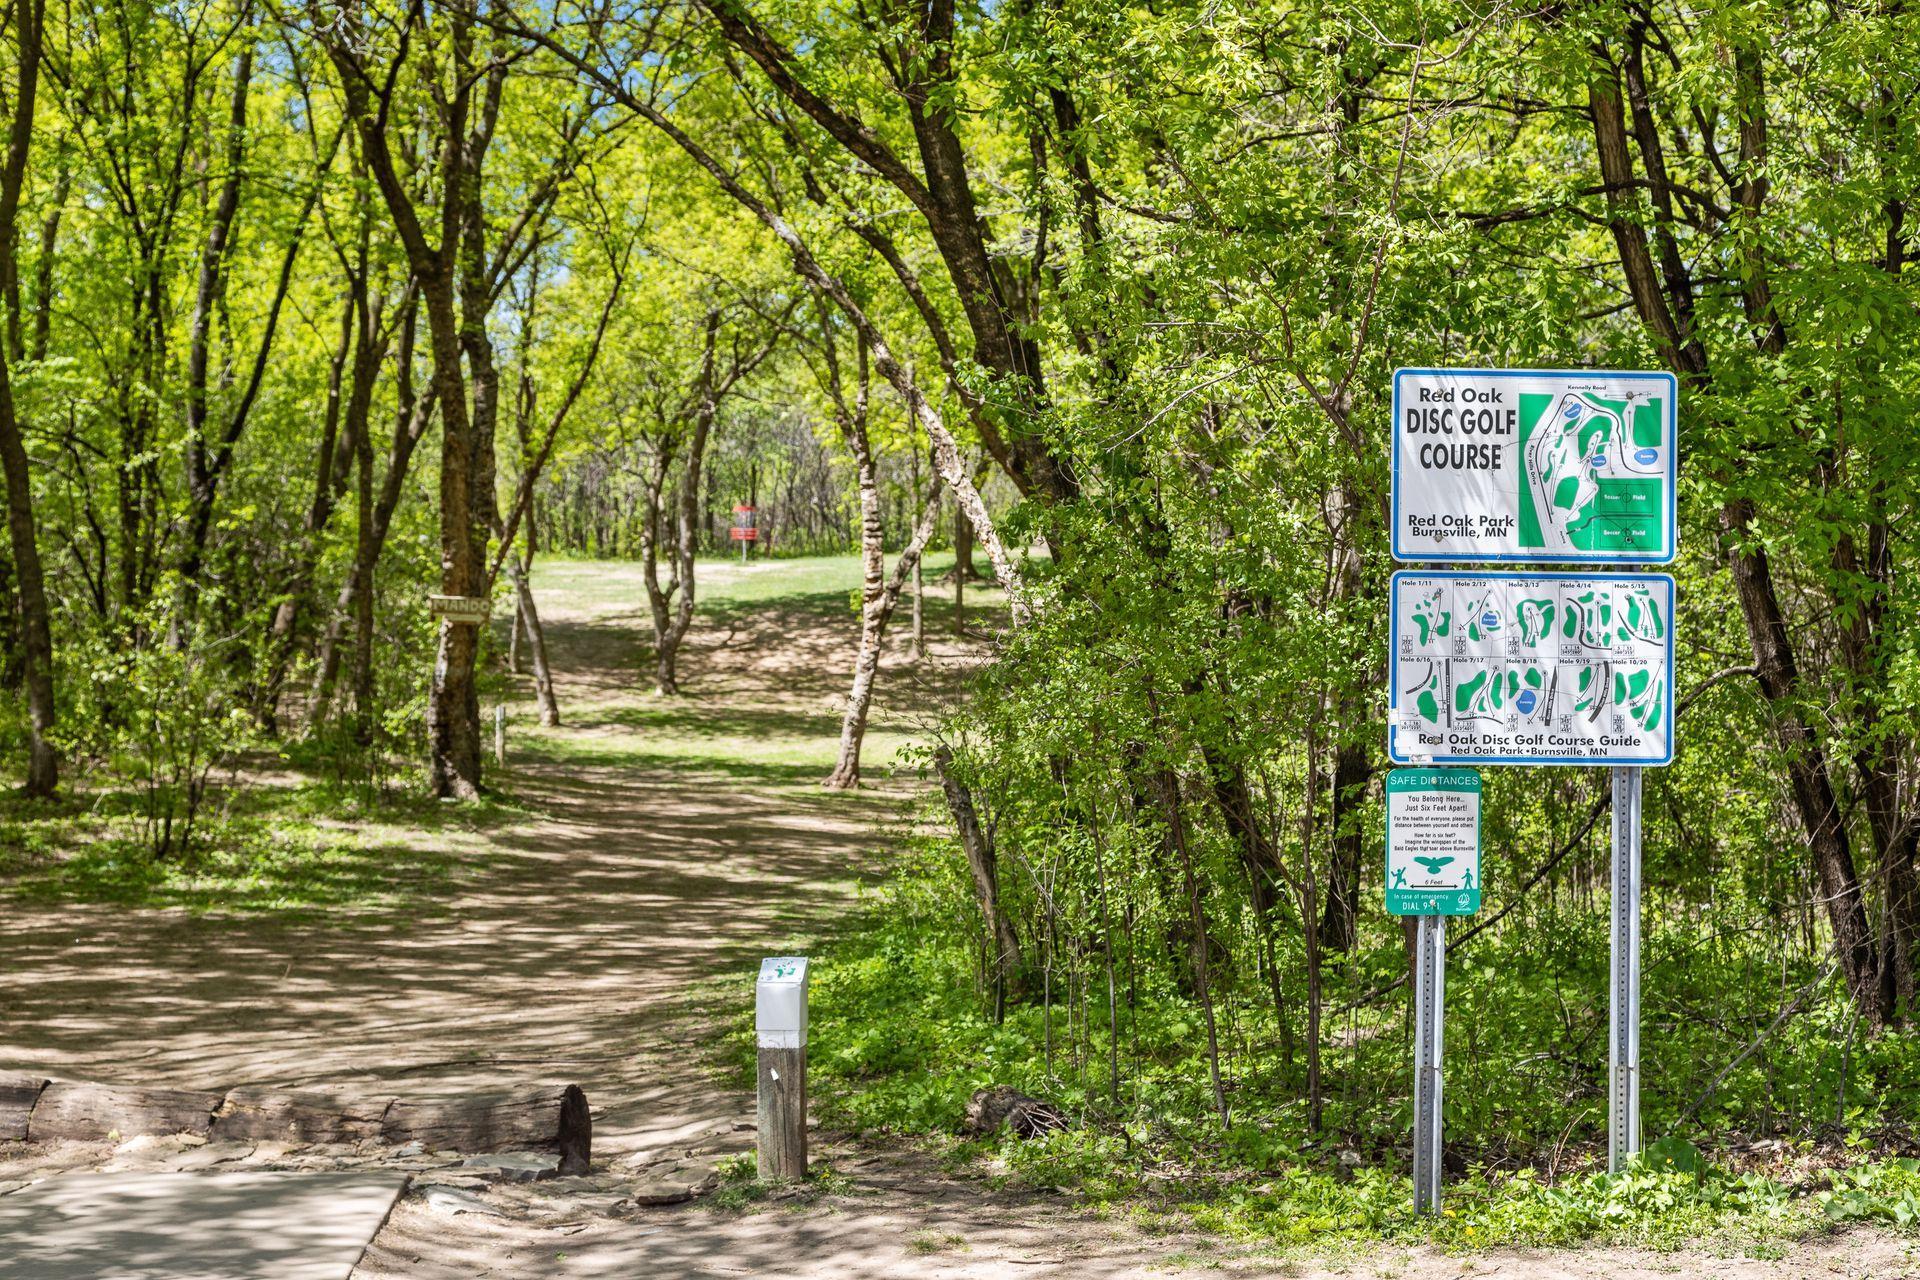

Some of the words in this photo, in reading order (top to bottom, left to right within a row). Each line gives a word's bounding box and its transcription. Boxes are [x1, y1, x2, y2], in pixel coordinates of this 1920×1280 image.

[1420, 387, 1454, 402] Red
[1461, 388, 1502, 403] Oak
[1407, 408, 1453, 434] DISC
[1461, 409, 1516, 434] GOLF
[1420, 443, 1501, 469] COURSE
[1408, 514, 1436, 526] Red
[1442, 514, 1473, 526] Oak
[1480, 515, 1514, 527] Park
[1412, 527, 1480, 538] Burnsville,
[1485, 528, 1507, 537] MN
[432, 600, 489, 611] MANDO
[1419, 734, 1443, 744] Red
[1449, 734, 1477, 744] Oak
[1483, 734, 1509, 745] Disc
[1514, 734, 1543, 745] Golf
[1548, 735, 1594, 746] Course
[1600, 735, 1640, 746] Guide
[1531, 747, 1586, 756] Burnsville,
[1390, 776, 1416, 785] SAFE
[1421, 776, 1478, 785] DITANCES
